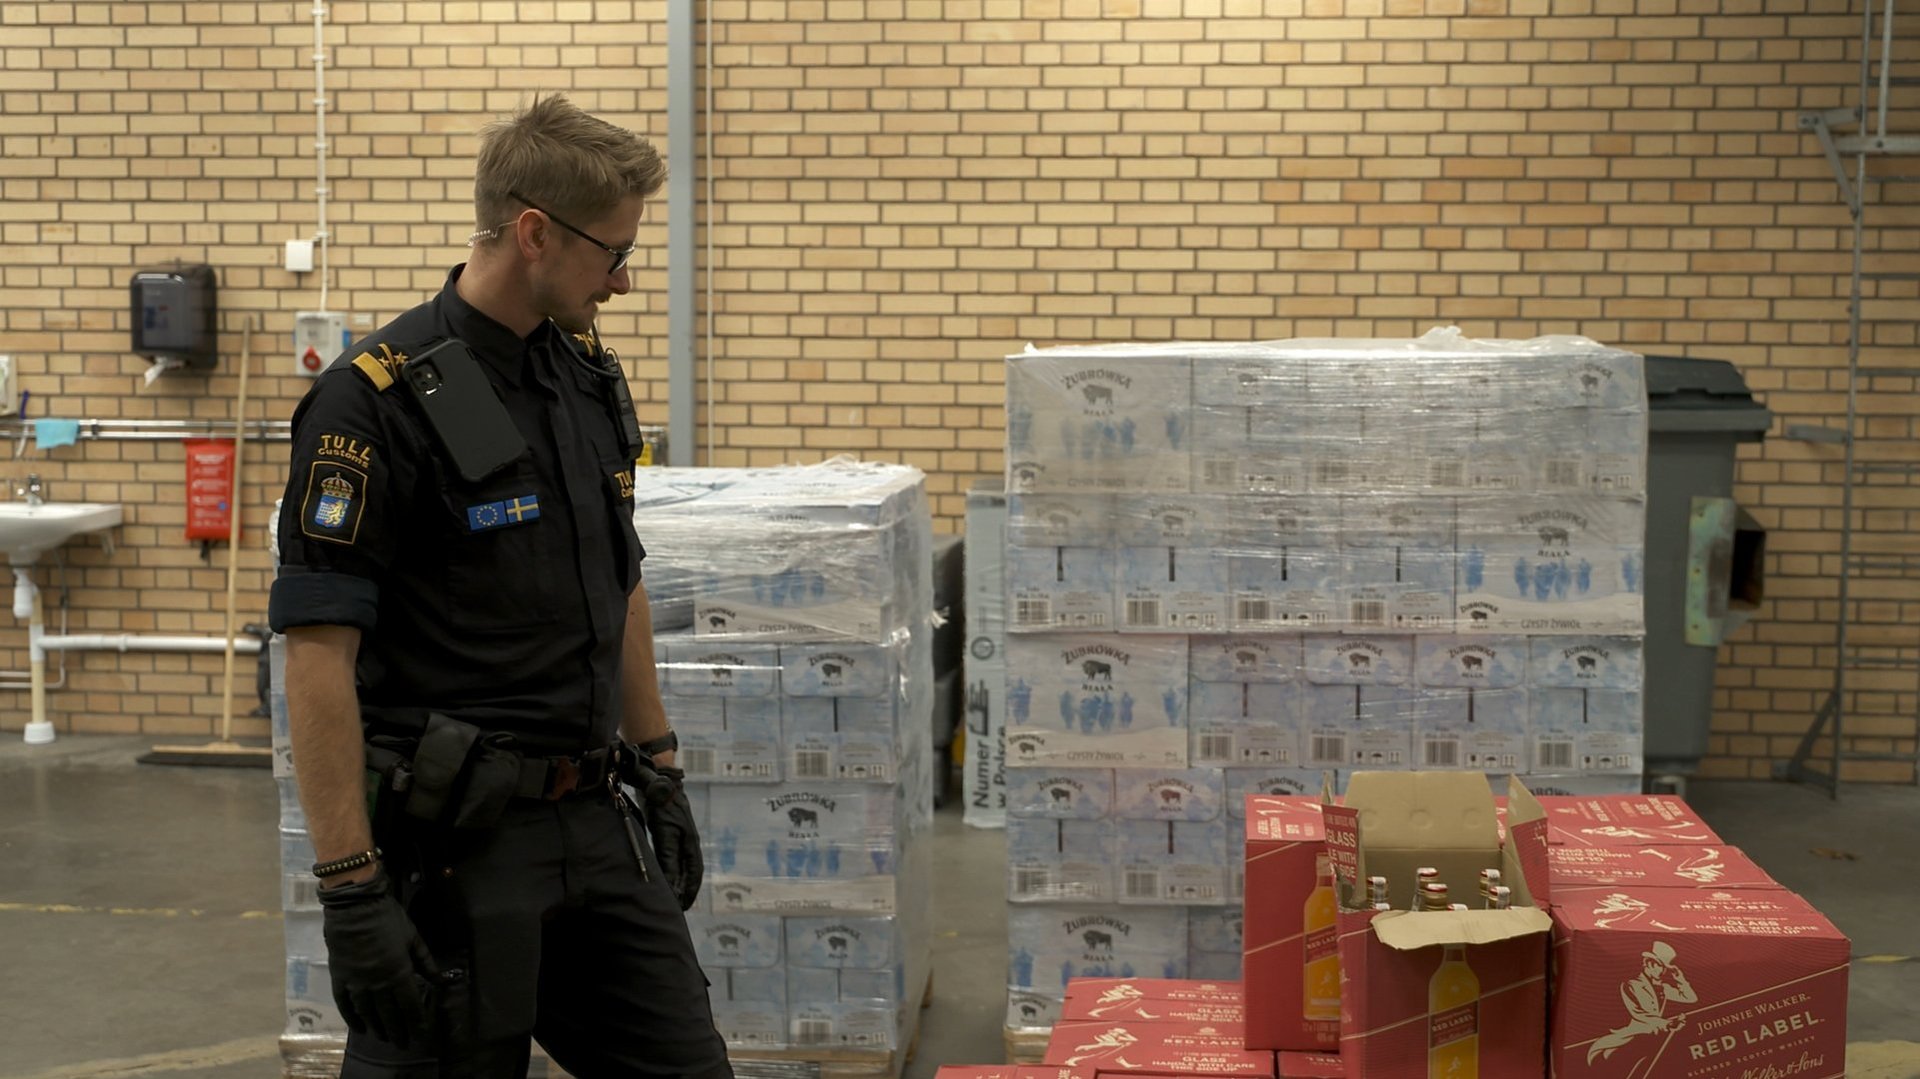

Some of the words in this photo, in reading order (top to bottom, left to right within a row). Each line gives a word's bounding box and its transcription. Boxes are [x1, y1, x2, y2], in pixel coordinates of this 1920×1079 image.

[317, 447, 370, 469] Customs
[320, 435, 371, 463] TULL
[973, 740, 990, 809] Numer
[1327, 828, 1356, 848] GLASS
[1689, 1034, 1737, 1060] RED
[1743, 1011, 1820, 1045] LABEL
[1697, 1008, 1753, 1036] JOHNNIE
[1754, 993, 1808, 1015] WALKER
[1687, 1061, 1732, 1077] BLENDED
[1736, 1048, 1774, 1063] SCOTCH
[1779, 1035, 1816, 1050] WHISKY
